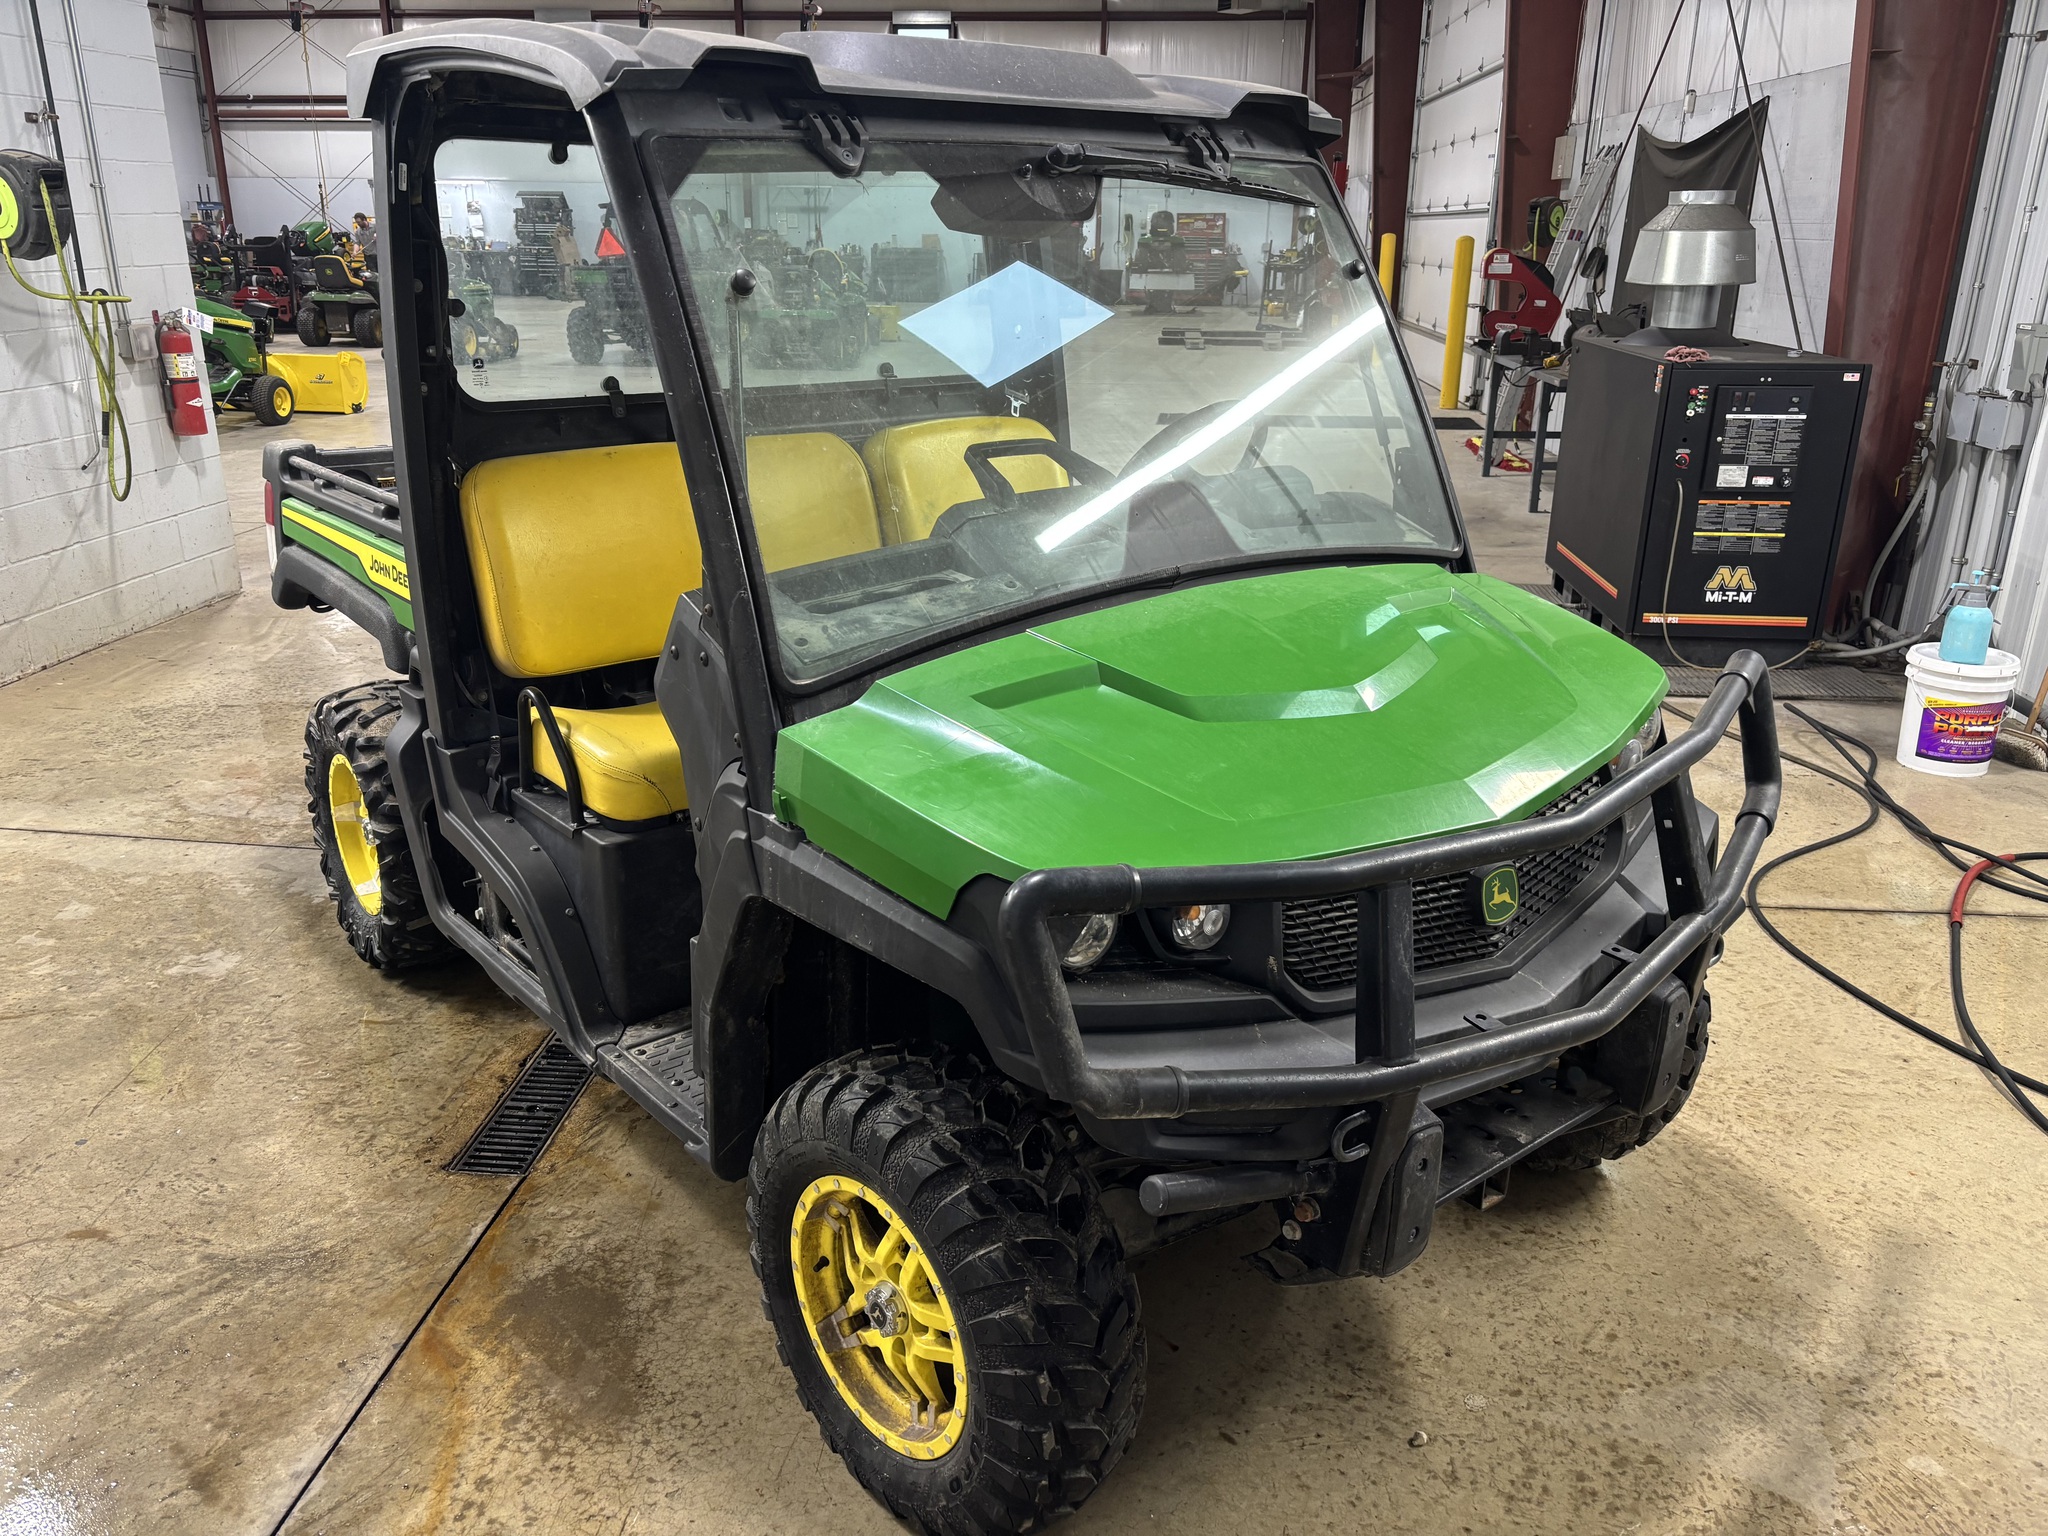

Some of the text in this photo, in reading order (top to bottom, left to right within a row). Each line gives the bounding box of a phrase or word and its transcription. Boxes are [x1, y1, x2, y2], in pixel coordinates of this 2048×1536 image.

[370, 555, 409, 588] JOHN DEE
[1705, 591, 1752, 603] Mi-T-M
[1667, 616, 1679, 624] PSI
